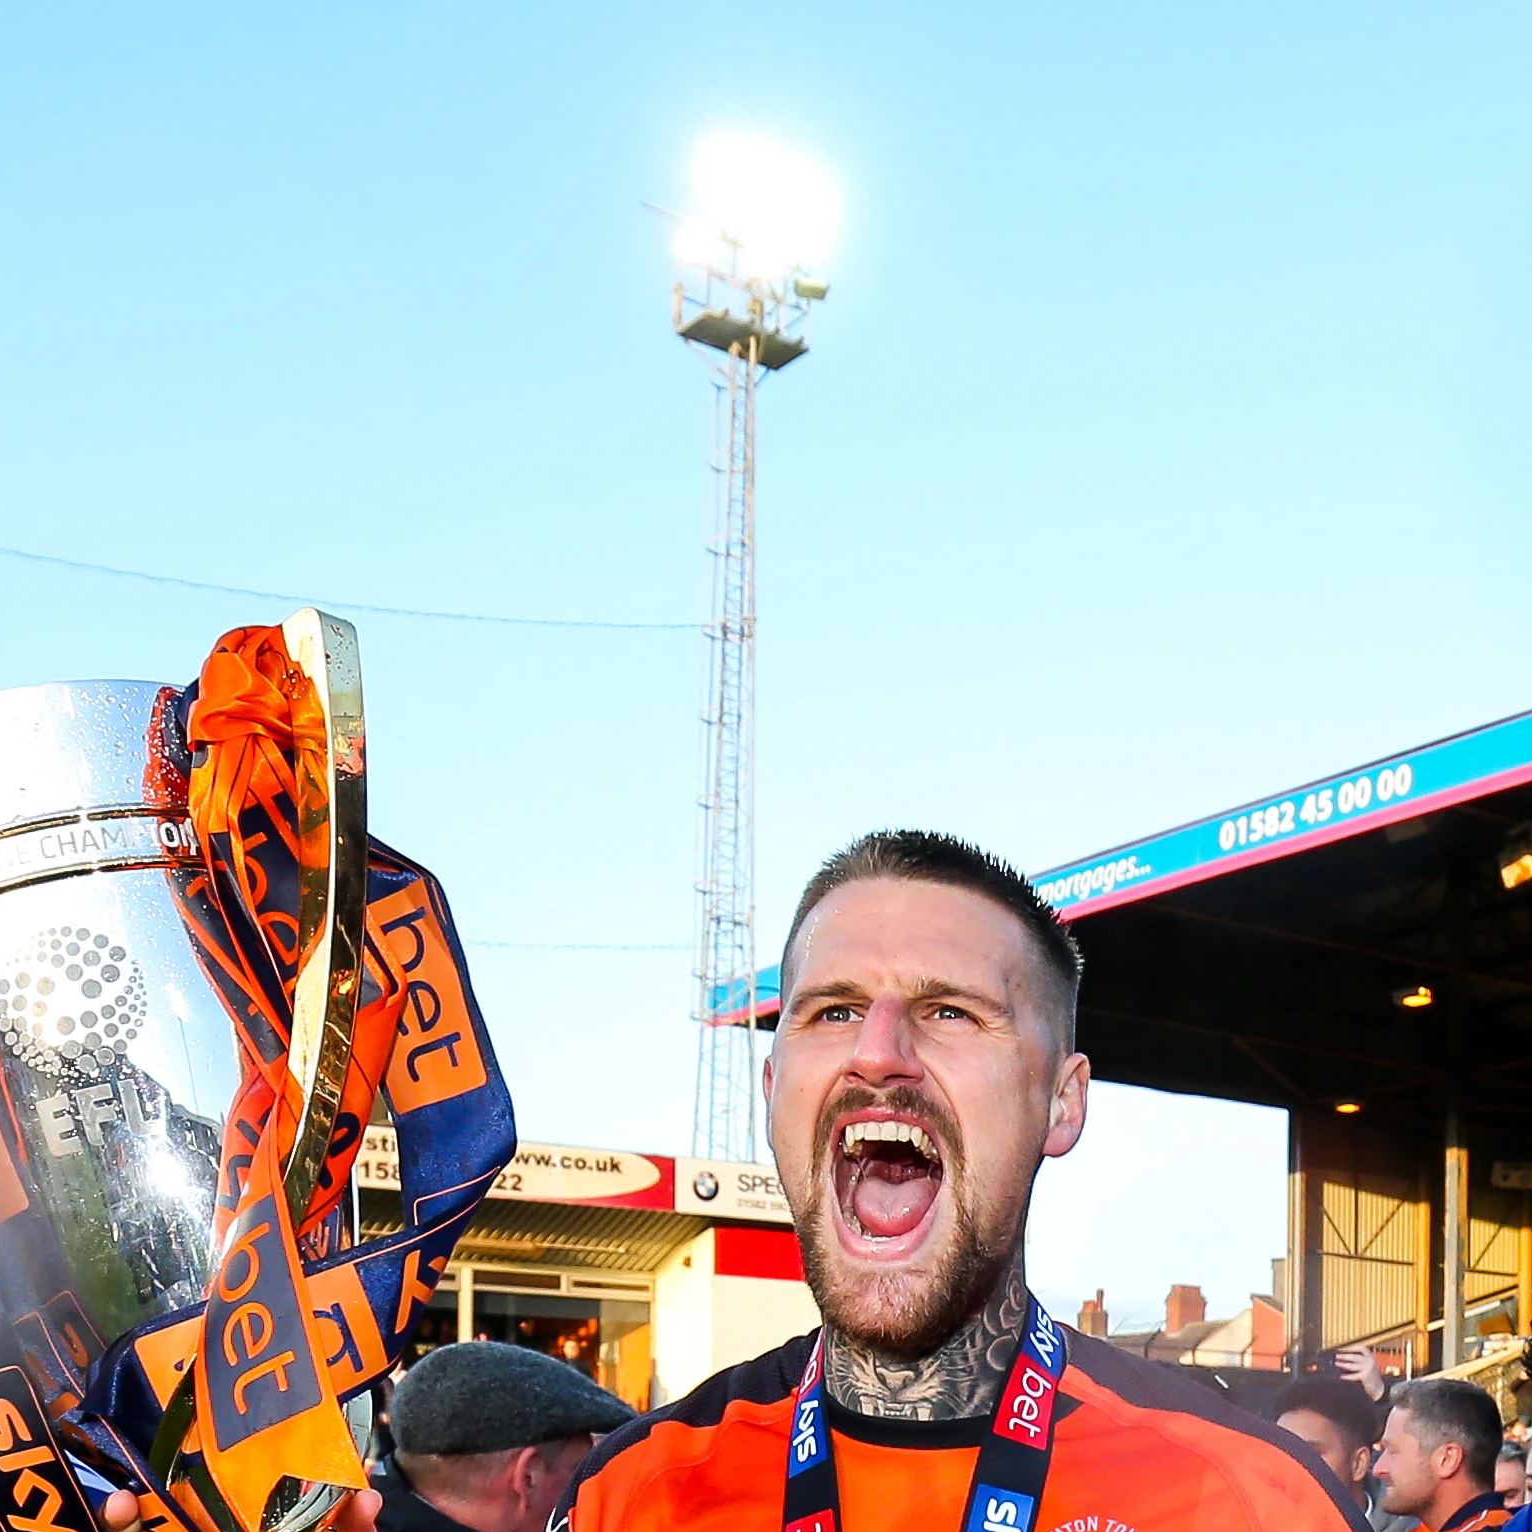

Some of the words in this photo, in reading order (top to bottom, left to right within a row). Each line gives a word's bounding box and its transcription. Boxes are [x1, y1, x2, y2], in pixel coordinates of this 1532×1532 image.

[1218, 801, 1296, 852] 01582
[1299, 789, 1334, 825] 45
[1337, 776, 1372, 815] 00
[1376, 763, 1414, 802] 00
[35, 1078, 169, 1158] EFL
[217, 1221, 297, 1417] bet
[1030, 1304, 1061, 1369] sky
[1009, 1367, 1053, 1440] bet
